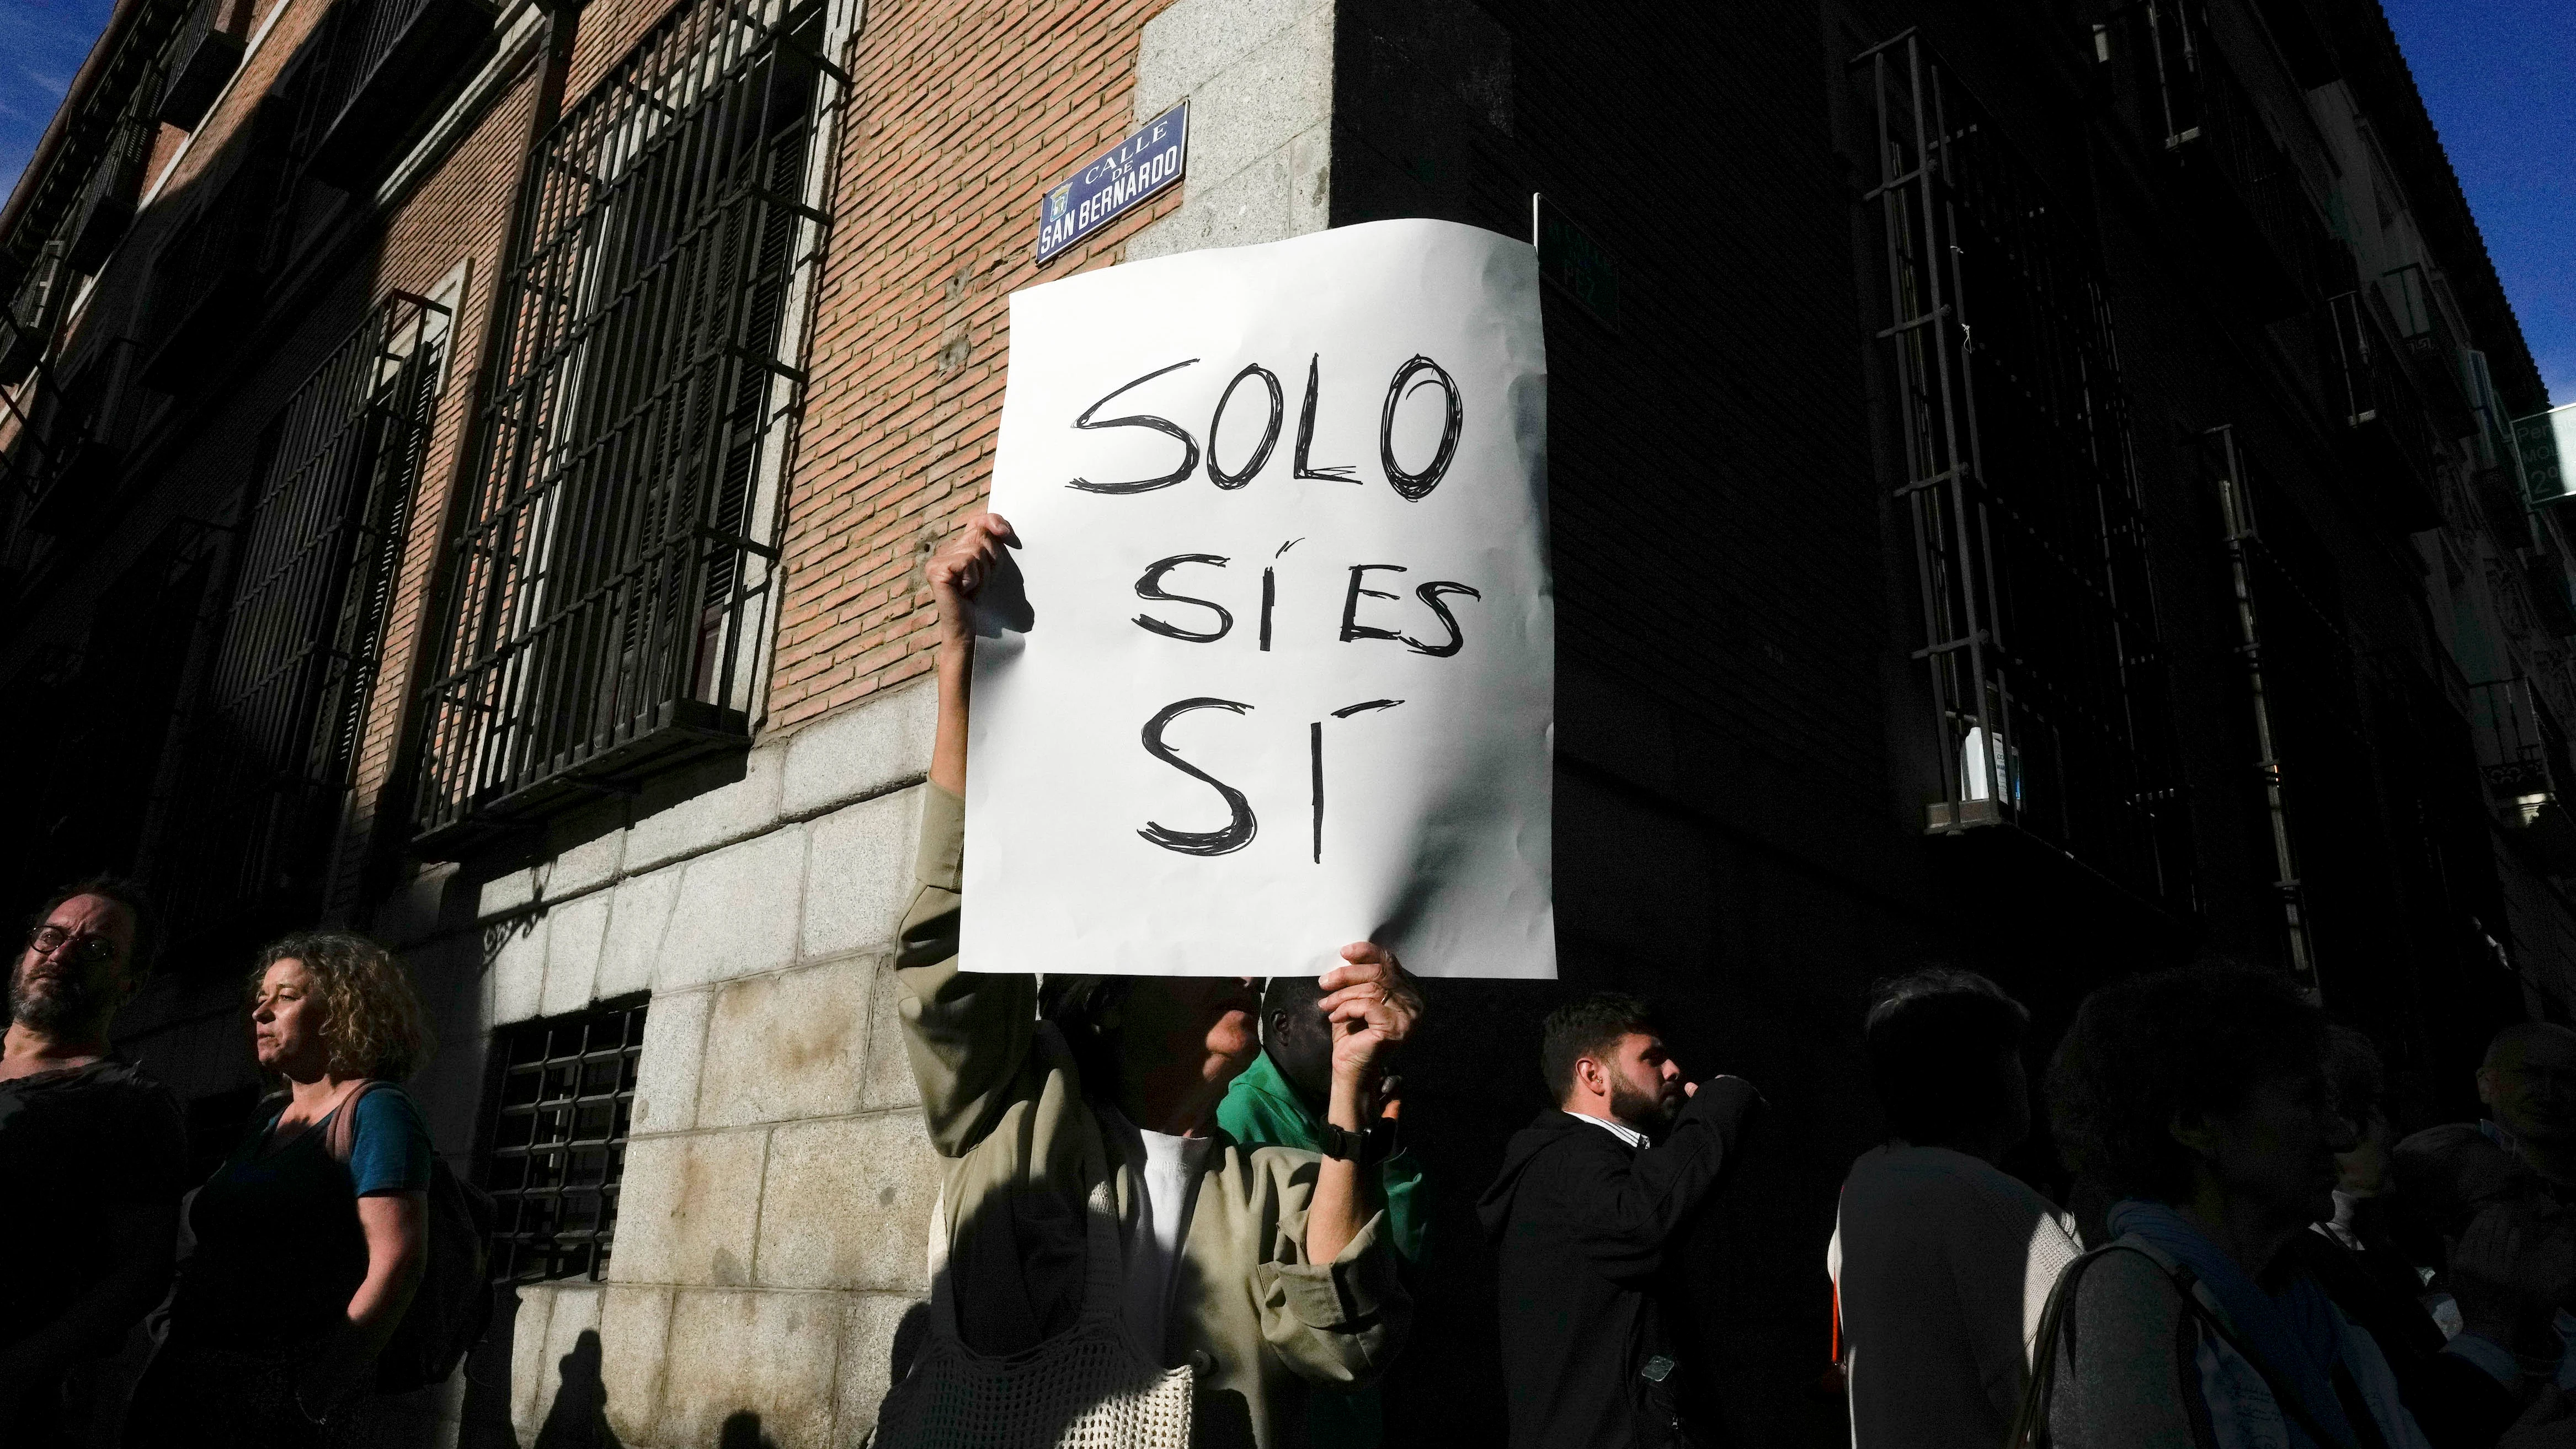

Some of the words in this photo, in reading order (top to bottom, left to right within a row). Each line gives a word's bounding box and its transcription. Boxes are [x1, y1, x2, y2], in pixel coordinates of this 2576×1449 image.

[1041, 209, 1075, 254] SAN
[1079, 145, 1177, 230] BERNARDO
[1085, 120, 1168, 184] CALLE
[1112, 160, 1134, 182] DE
[1064, 353, 1463, 502] SOLO
[1131, 537, 1305, 652] SÍ
[1340, 564, 1481, 658] ES
[1137, 697, 1405, 864] SÍ
